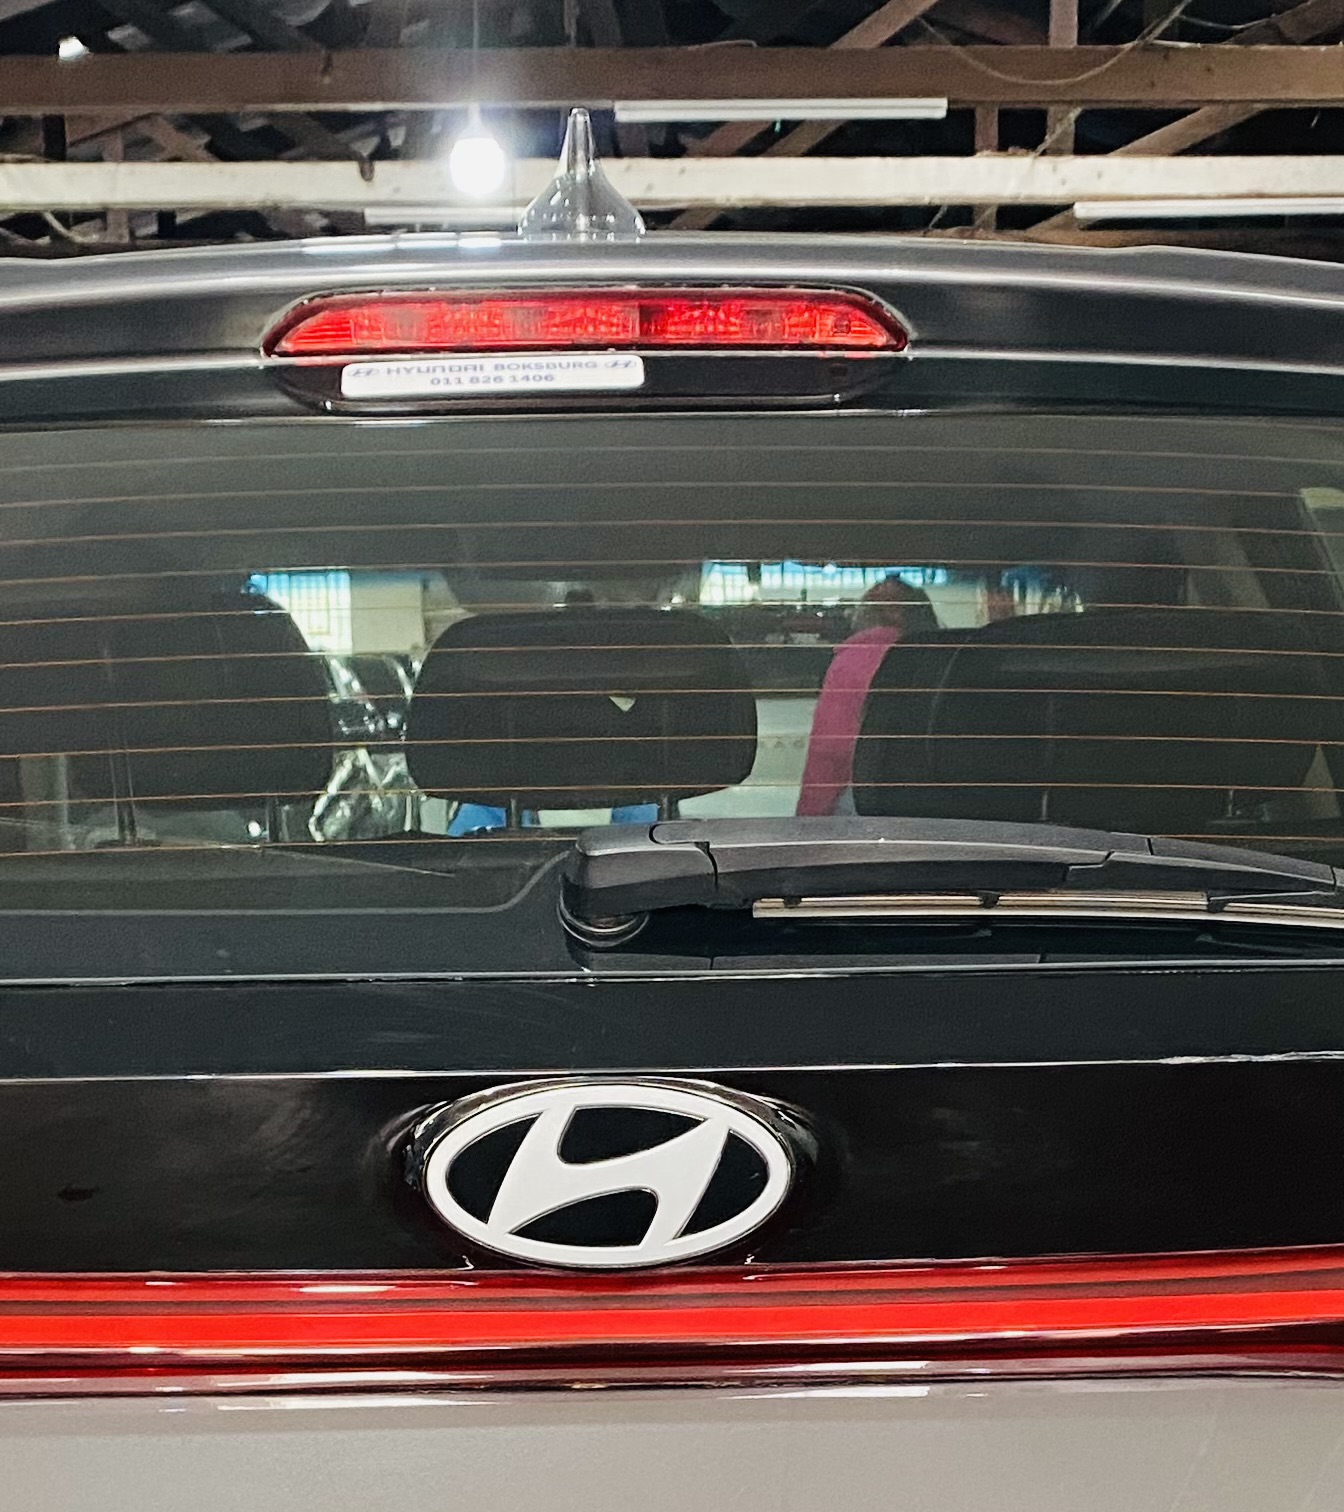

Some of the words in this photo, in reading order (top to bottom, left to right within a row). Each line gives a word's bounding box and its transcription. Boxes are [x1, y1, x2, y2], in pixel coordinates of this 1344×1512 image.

[387, 364, 485, 375] HYUNDAI
[494, 361, 598, 371] BOKSBURG
[430, 377, 464, 385] 011
